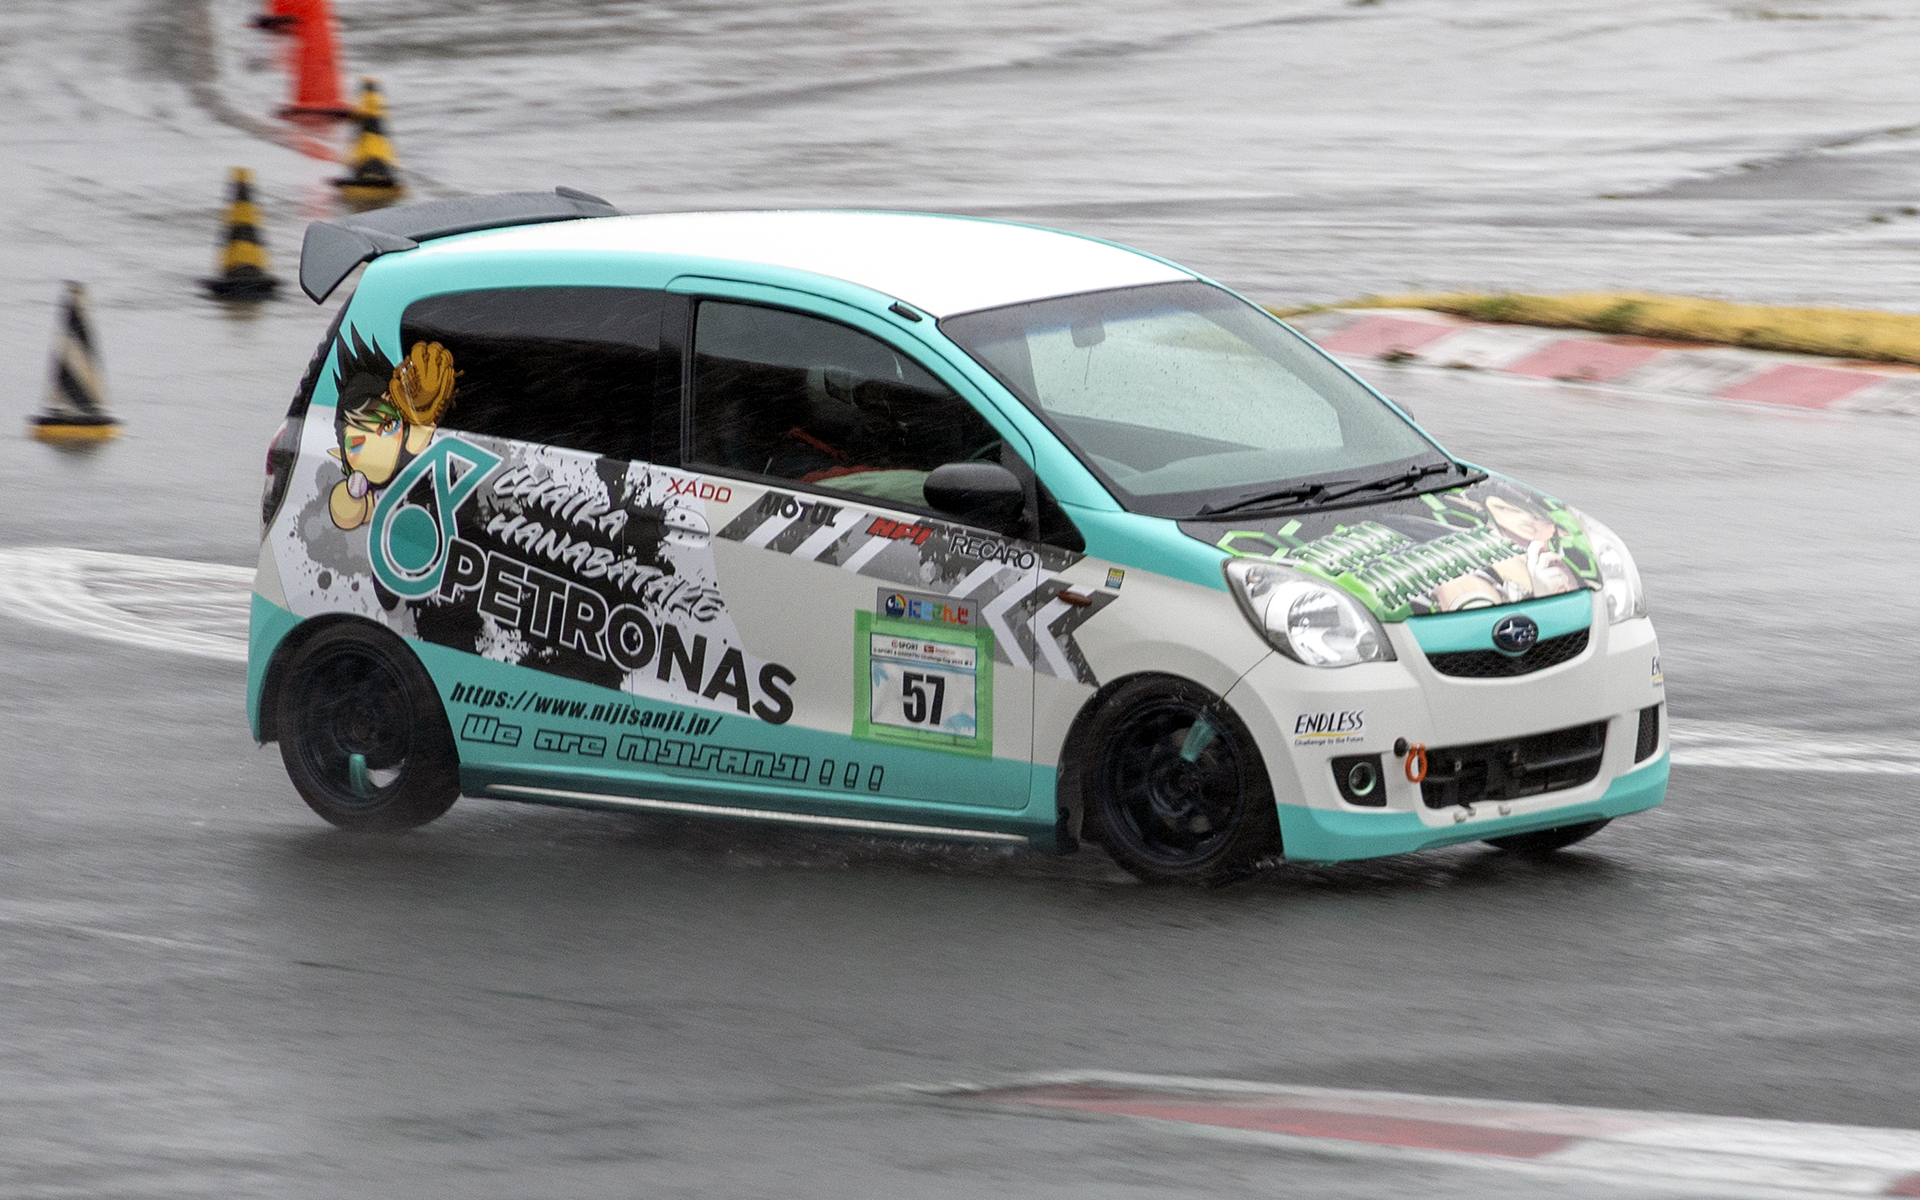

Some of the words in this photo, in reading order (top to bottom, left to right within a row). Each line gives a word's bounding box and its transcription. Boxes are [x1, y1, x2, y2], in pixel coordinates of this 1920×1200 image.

[666, 477, 732, 504] XADO
[757, 493, 838, 528] MOTUL
[950, 533, 1036, 570] RECARO
[438, 535, 797, 725] PETRONAS
[450, 681, 723, 736] https://www.nijisanji.jp/
[902, 670, 945, 726] 57
[460, 713, 522, 748] We
[533, 728, 607, 758] are
[1294, 710, 1364, 734] ENDLESS
